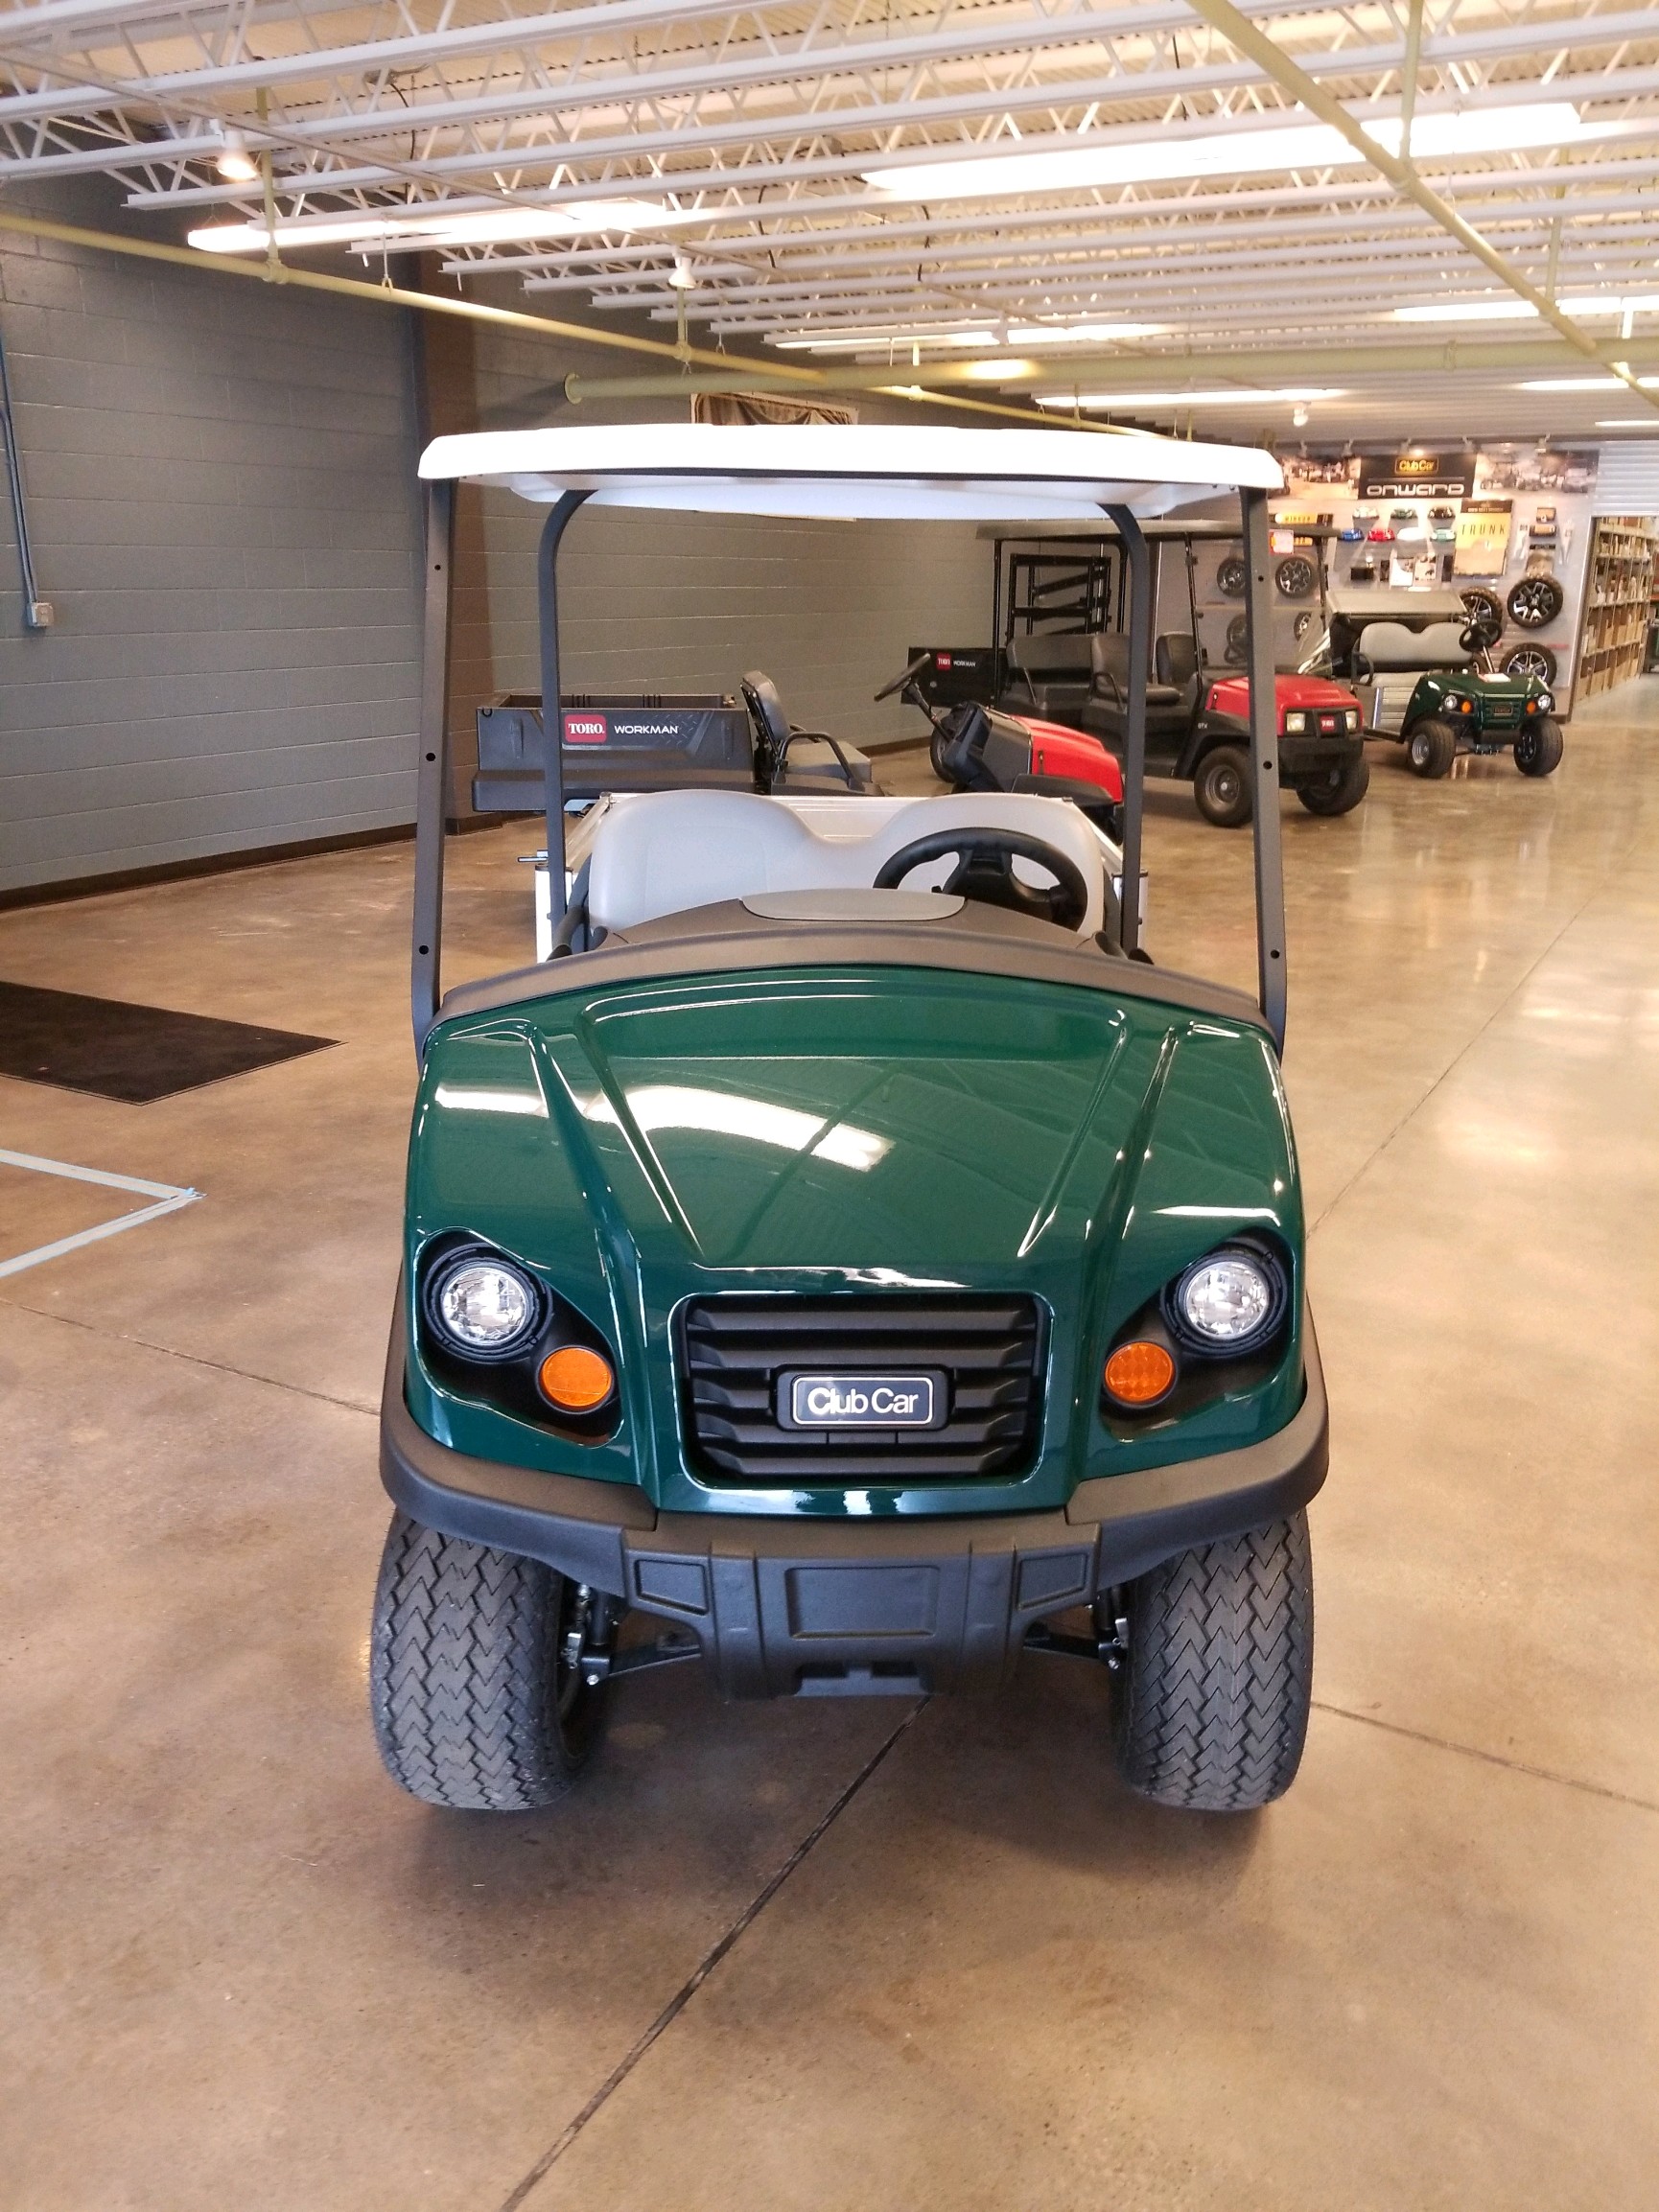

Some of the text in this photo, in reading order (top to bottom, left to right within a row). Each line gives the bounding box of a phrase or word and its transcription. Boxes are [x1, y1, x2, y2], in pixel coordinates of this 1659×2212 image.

[1399, 459, 1419, 471] Club
[568, 723, 679, 734] TORO WORKMAN
[807, 1386, 919, 1415] Club Car
